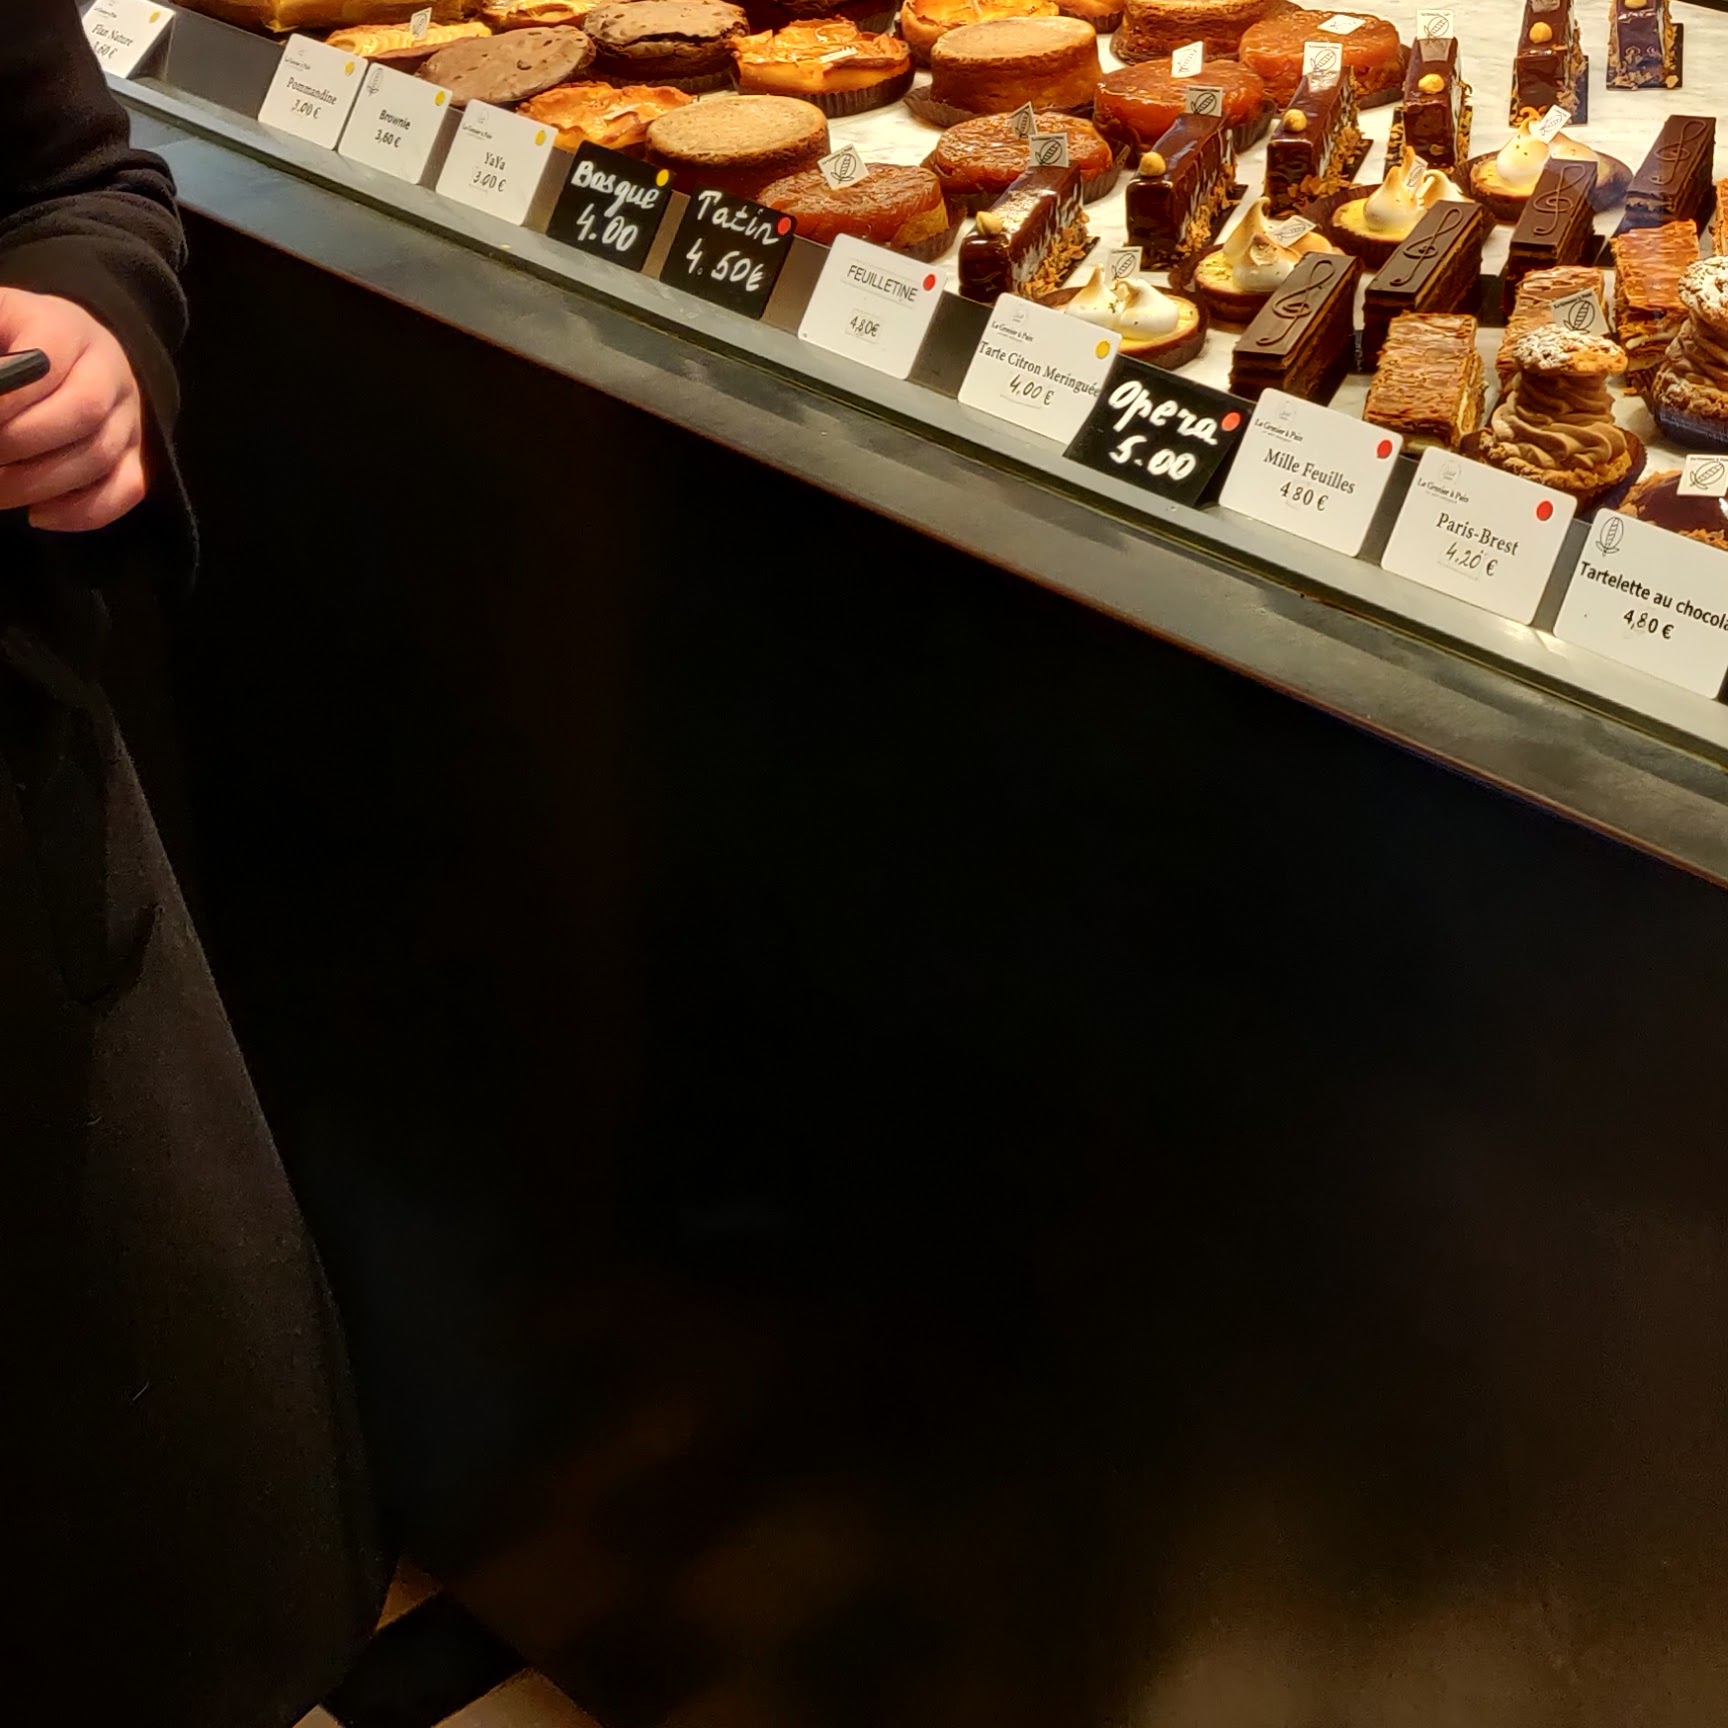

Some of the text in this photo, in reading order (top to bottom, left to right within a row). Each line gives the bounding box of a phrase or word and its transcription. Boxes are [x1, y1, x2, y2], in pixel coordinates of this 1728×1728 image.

[92, 24, 134, 47] Flan Nature
[286, 77, 337, 105] Pommandine
[312, 106, 322, 119] €
[379, 109, 411, 130] Brownie
[394, 136, 402, 148] €
[484, 152, 506, 171] YaYa
[497, 178, 507, 192] €
[576, 203, 638, 252] 4.00
[697, 190, 781, 245] Tatin
[847, 264, 918, 303] FEUILLETINE
[978, 340, 1101, 397] Tarte Citron Meringuée
[1043, 390, 1054, 406] €
[1107, 379, 1218, 446] Opera
[1255, 418, 1263, 427] Le
[1263, 448, 1355, 494] Mille Feuilles
[1417, 477, 1431, 489] Le
[1317, 495, 1330, 511] €
[1435, 512, 1520, 556] Paris-Brest
[1485, 559, 1498, 577] €
[1579, 561, 1651, 601] Tartelette
[1653, 591, 1673, 610] au
[1623, 608, 1675, 640] 4,80 €
